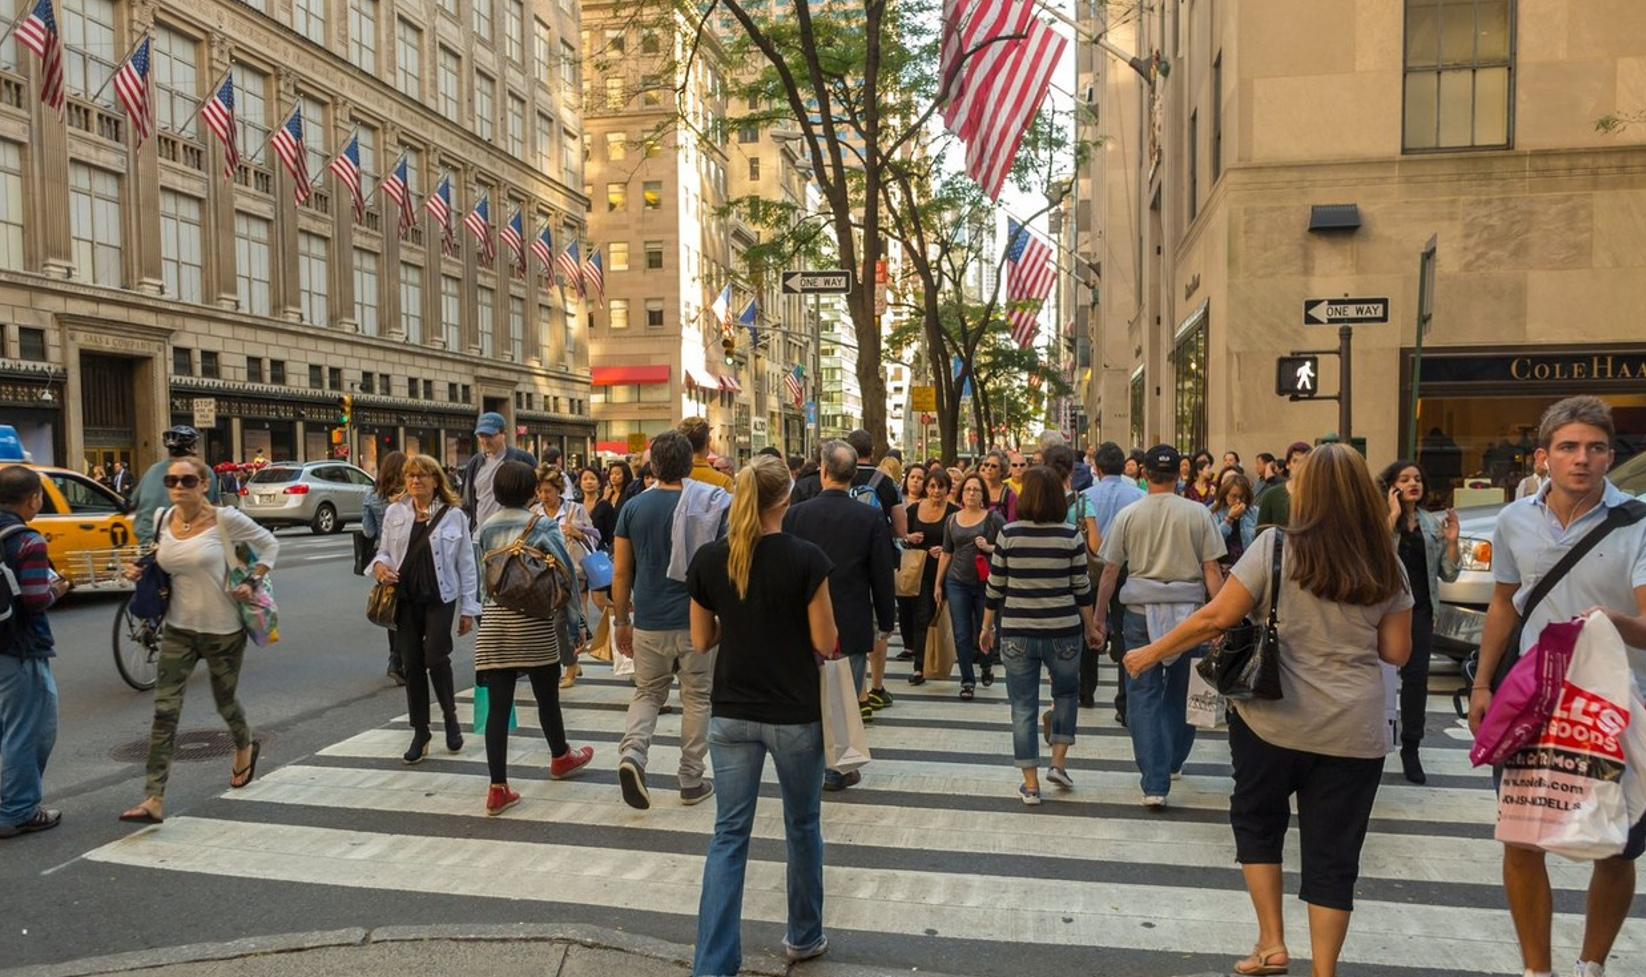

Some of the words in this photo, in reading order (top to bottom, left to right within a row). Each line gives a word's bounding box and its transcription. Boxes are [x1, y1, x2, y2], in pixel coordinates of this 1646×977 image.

[800, 277, 819, 287] ONE
[823, 277, 843, 287] WAY
[1326, 306, 1349, 317] ONE
[1355, 305, 1379, 316] WAY
[195, 400, 214, 408] STOP
